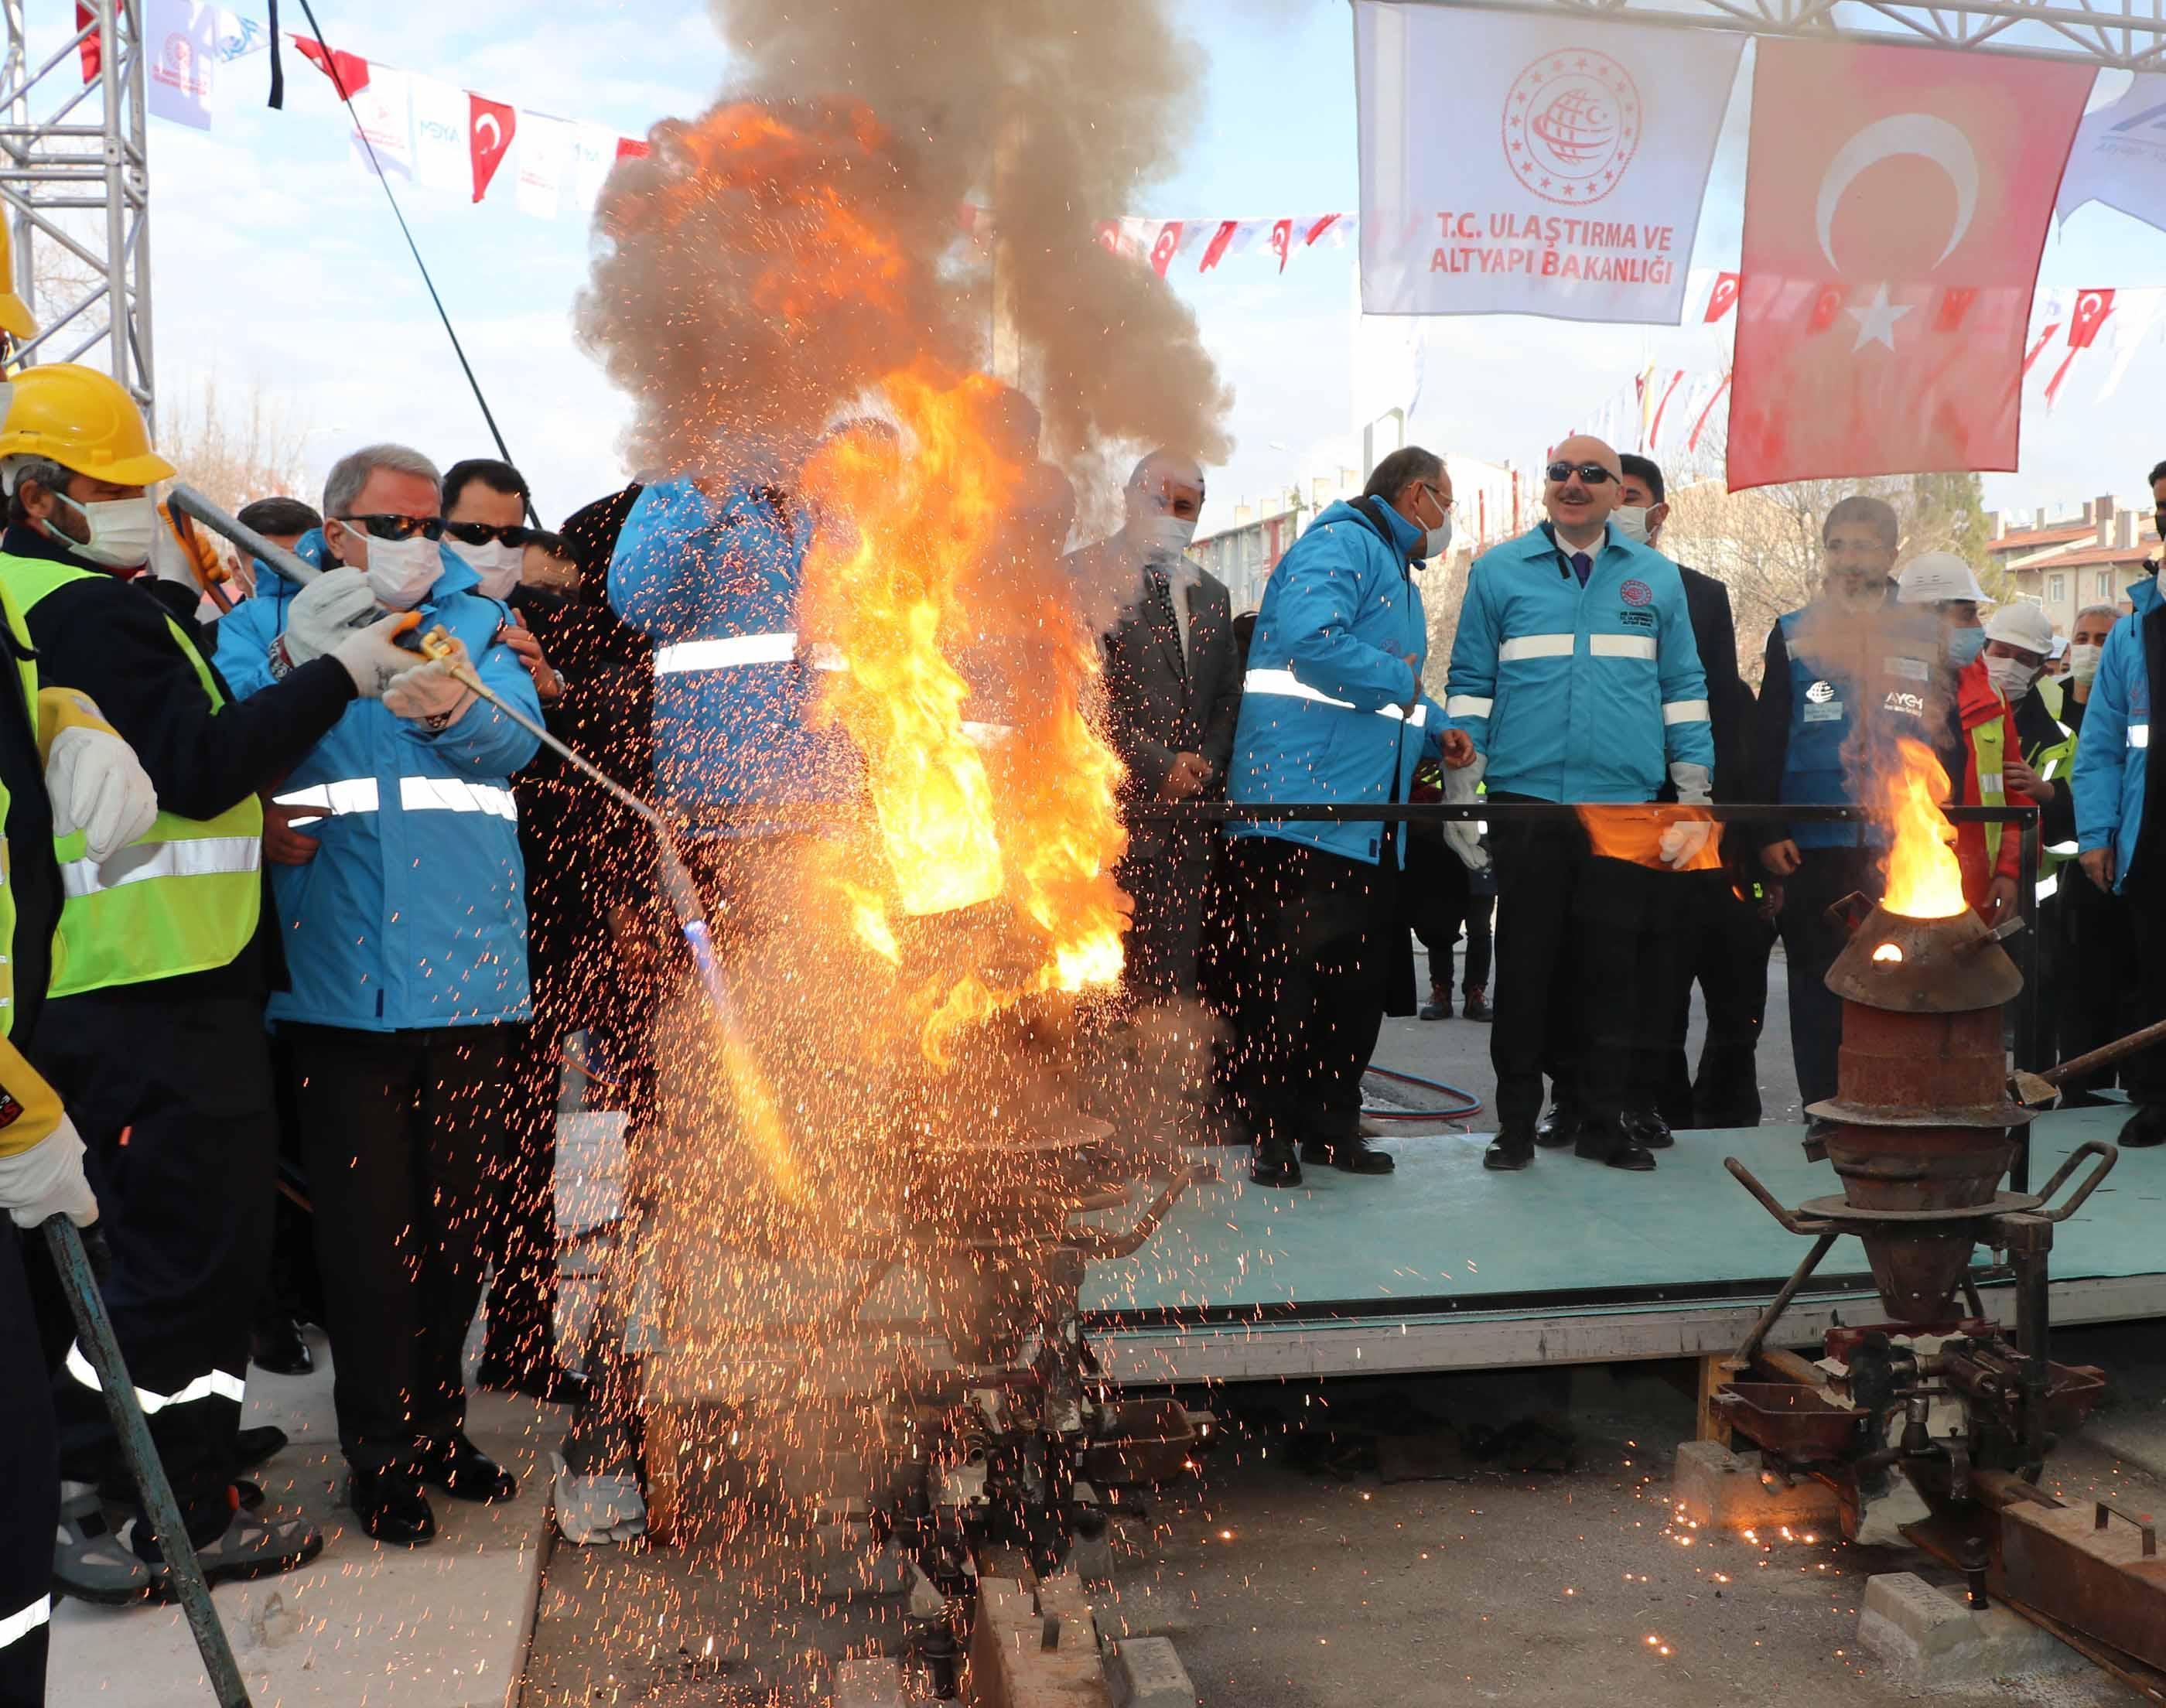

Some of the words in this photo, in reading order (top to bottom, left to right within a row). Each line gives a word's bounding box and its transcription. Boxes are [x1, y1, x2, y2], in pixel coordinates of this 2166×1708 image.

[1437, 212, 1481, 238] T.C.
[1491, 213, 1636, 248] ULAŞTIRMA
[1645, 225, 1673, 251] VE
[1430, 248, 1534, 272] ALTYAPI
[1541, 251, 1673, 284] BAKANLIĞI
